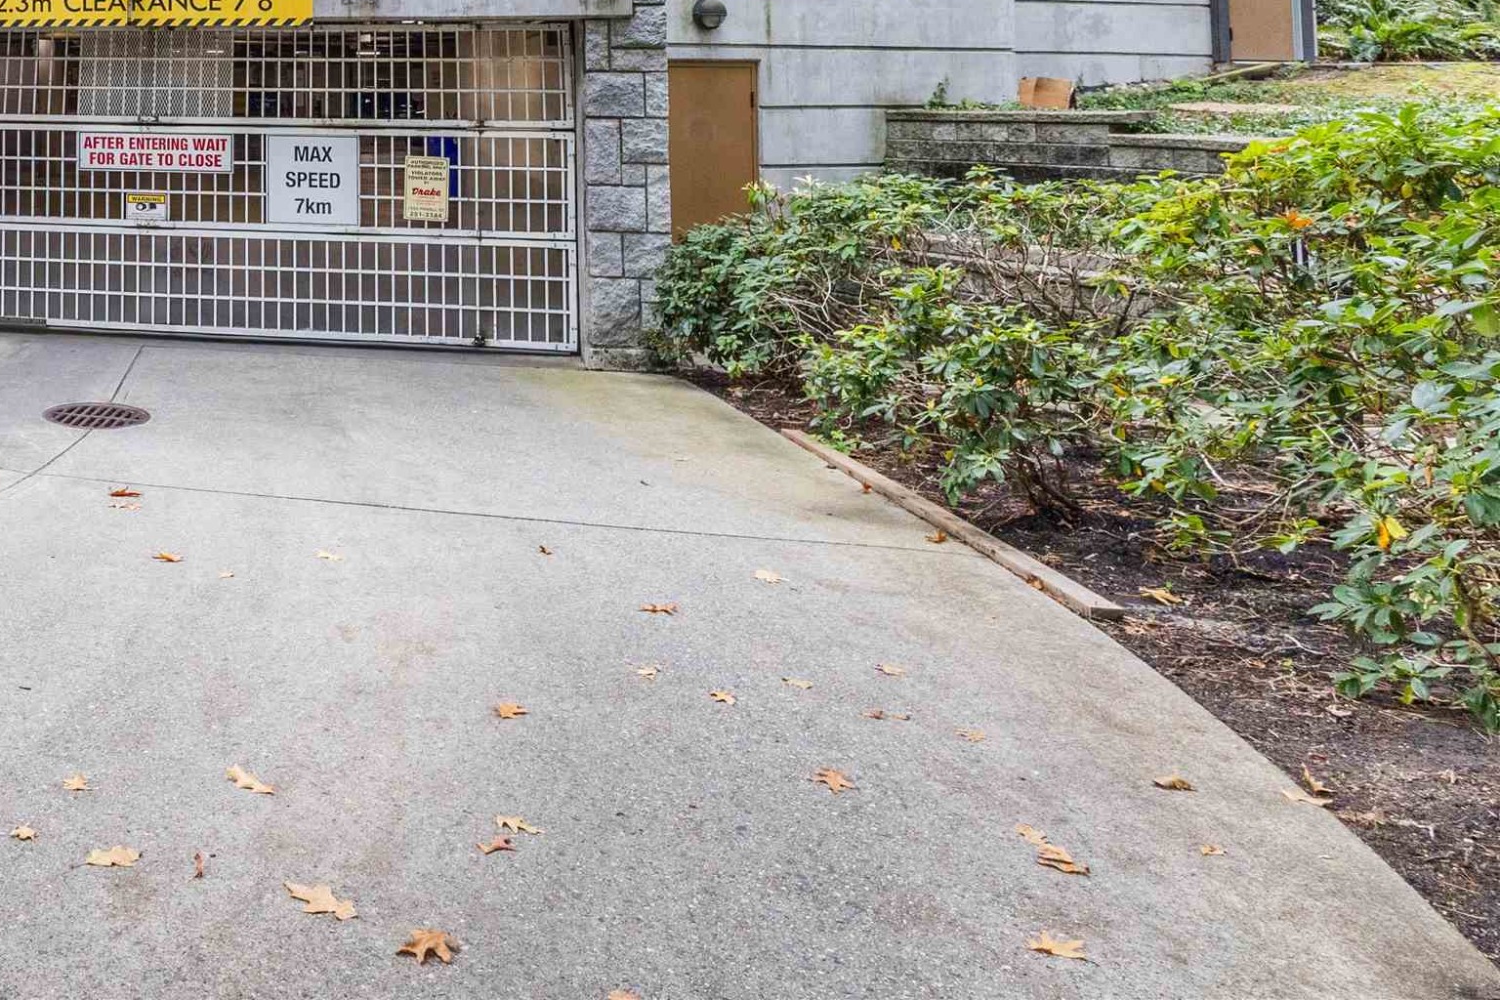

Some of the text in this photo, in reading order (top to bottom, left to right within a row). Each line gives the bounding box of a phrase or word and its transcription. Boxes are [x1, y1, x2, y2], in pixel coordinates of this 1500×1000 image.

[84, 136, 228, 151] AFTER ENTERING WAIT
[89, 152, 222, 167] FOR GATE TO CLOSE
[294, 145, 332, 162] MAX
[285, 171, 341, 188] SPEED
[412, 187, 442, 197] Drake
[294, 198, 332, 215] 7km
